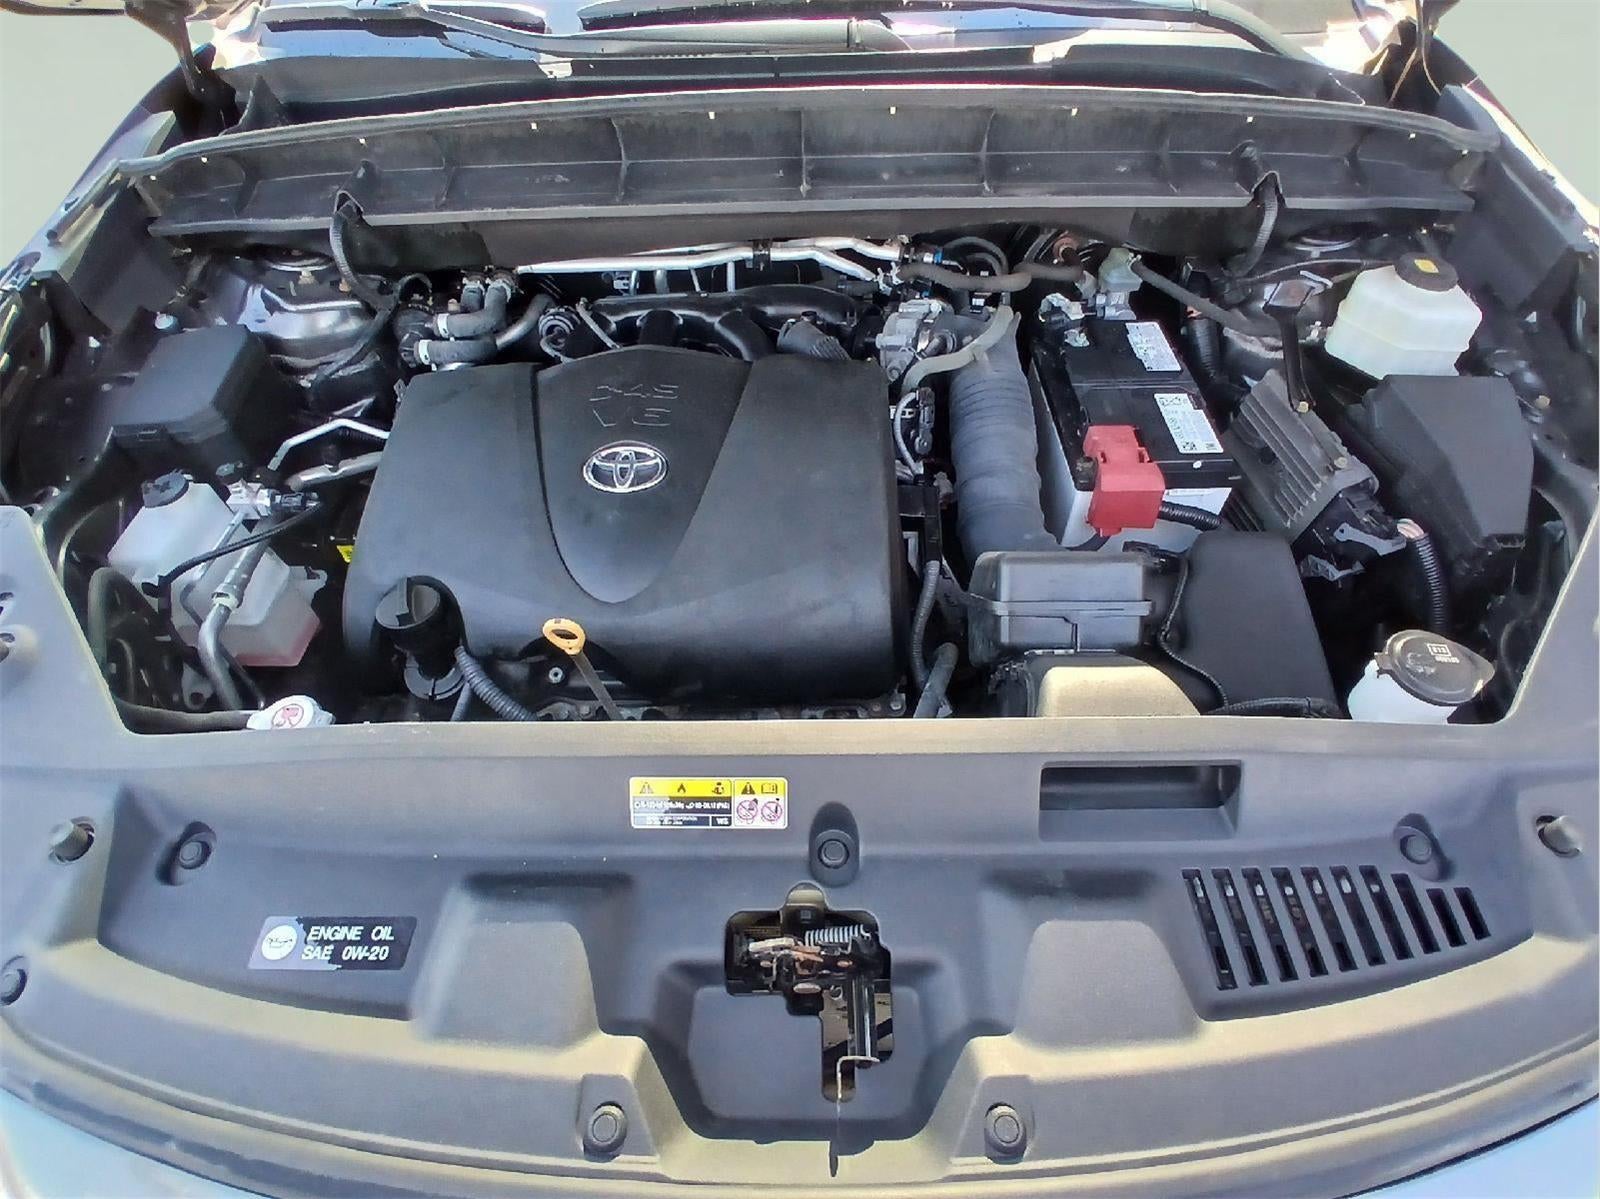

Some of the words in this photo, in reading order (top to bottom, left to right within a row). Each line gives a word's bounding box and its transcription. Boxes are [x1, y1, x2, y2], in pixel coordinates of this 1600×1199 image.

[306, 925, 365, 942] ENGINE
[370, 925, 395, 942] OIL
[301, 944, 335, 960] SAE
[341, 945, 390, 961] 0W-20
